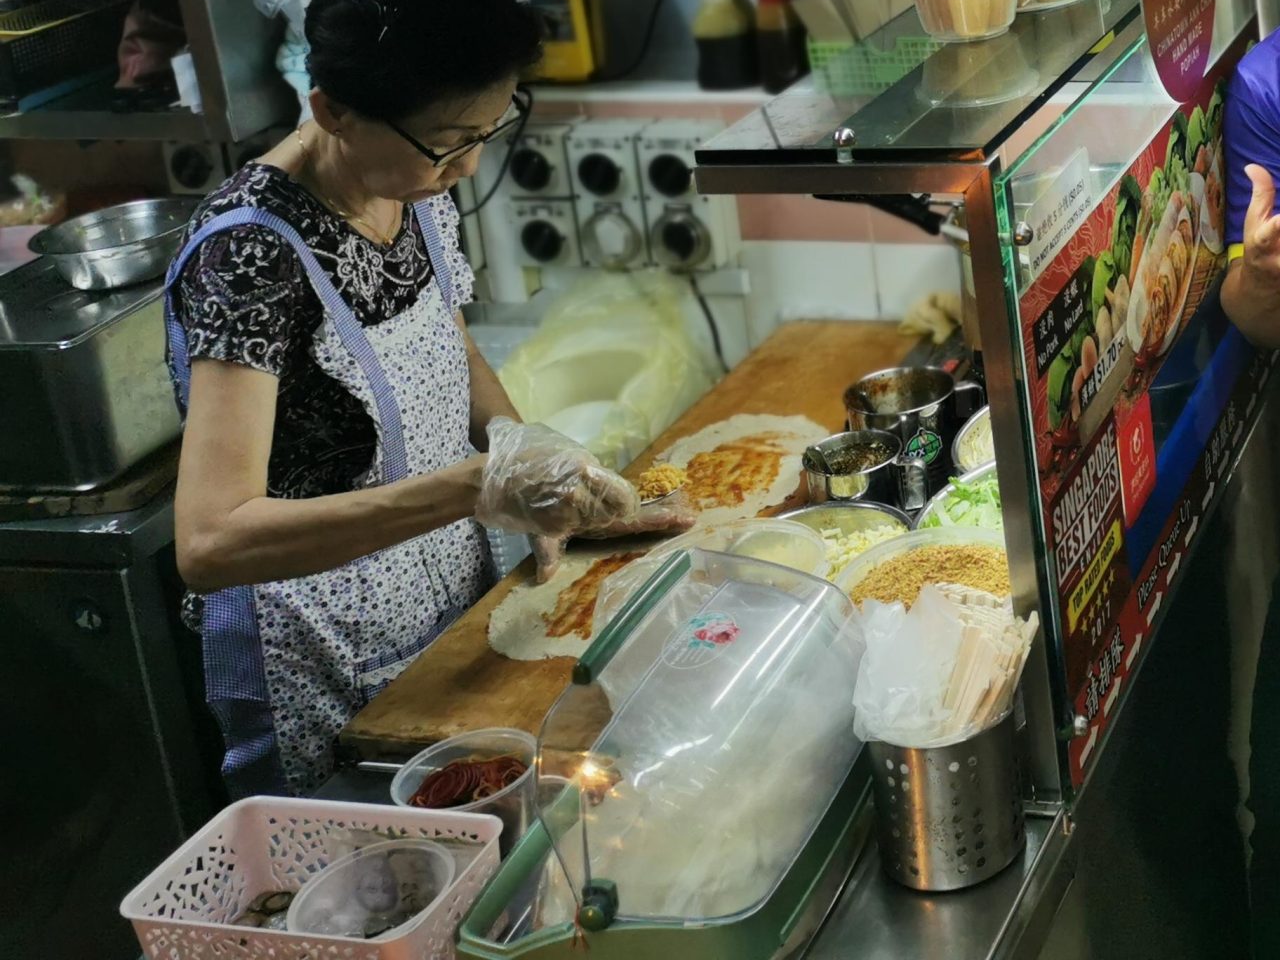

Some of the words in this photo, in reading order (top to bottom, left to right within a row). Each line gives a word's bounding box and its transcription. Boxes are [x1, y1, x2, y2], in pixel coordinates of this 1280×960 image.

[1064, 317, 1073, 333] No
[1038, 352, 1047, 369] No
[1046, 334, 1059, 358] Pork
[1097, 342, 1116, 384] $1.70
[1053, 422, 1117, 544] SINGAPORE
[1058, 513, 1086, 574] BEST
[1088, 465, 1118, 534] FOODS
[1072, 587, 1084, 613] TOP
[1084, 560, 1100, 592] RATED
[1138, 566, 1158, 610] Please
[1159, 521, 1179, 567] Queue
[1091, 599, 1111, 646] 2017
